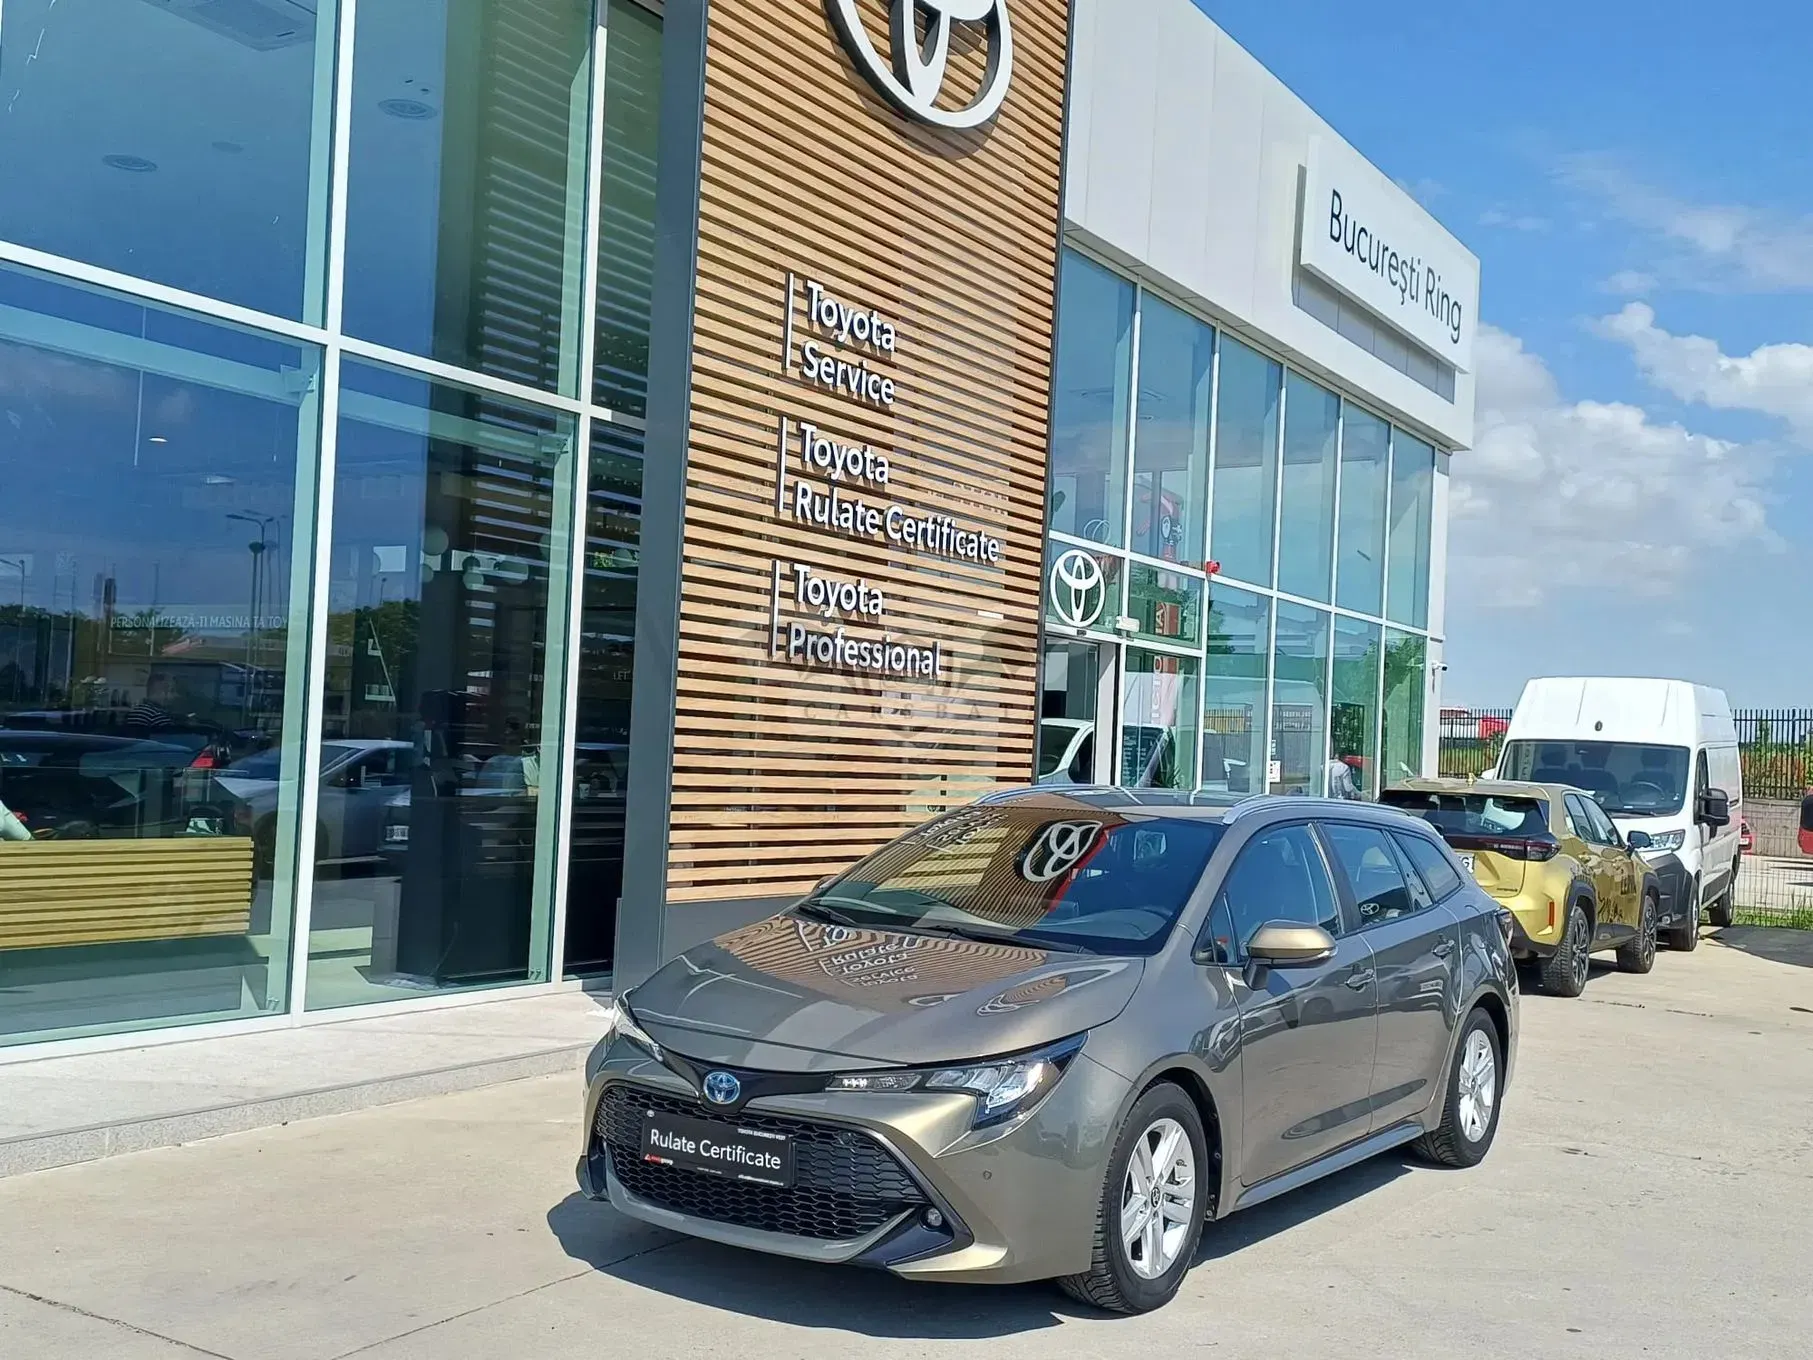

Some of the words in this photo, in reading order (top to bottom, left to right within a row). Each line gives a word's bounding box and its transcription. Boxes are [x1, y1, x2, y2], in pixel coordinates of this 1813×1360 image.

[806, 281, 896, 352] Toyota
[1425, 266, 1462, 344] Ring
[802, 342, 896, 405] Service
[801, 423, 890, 483] Toyota
[795, 481, 880, 535] Rulate
[885, 506, 1000, 563] Certificate
[794, 564, 884, 616] Toyota
[789, 622, 942, 676] Professional
[650, 1128, 696, 1153] Rulate
[699, 1139, 781, 1169] Certificate
